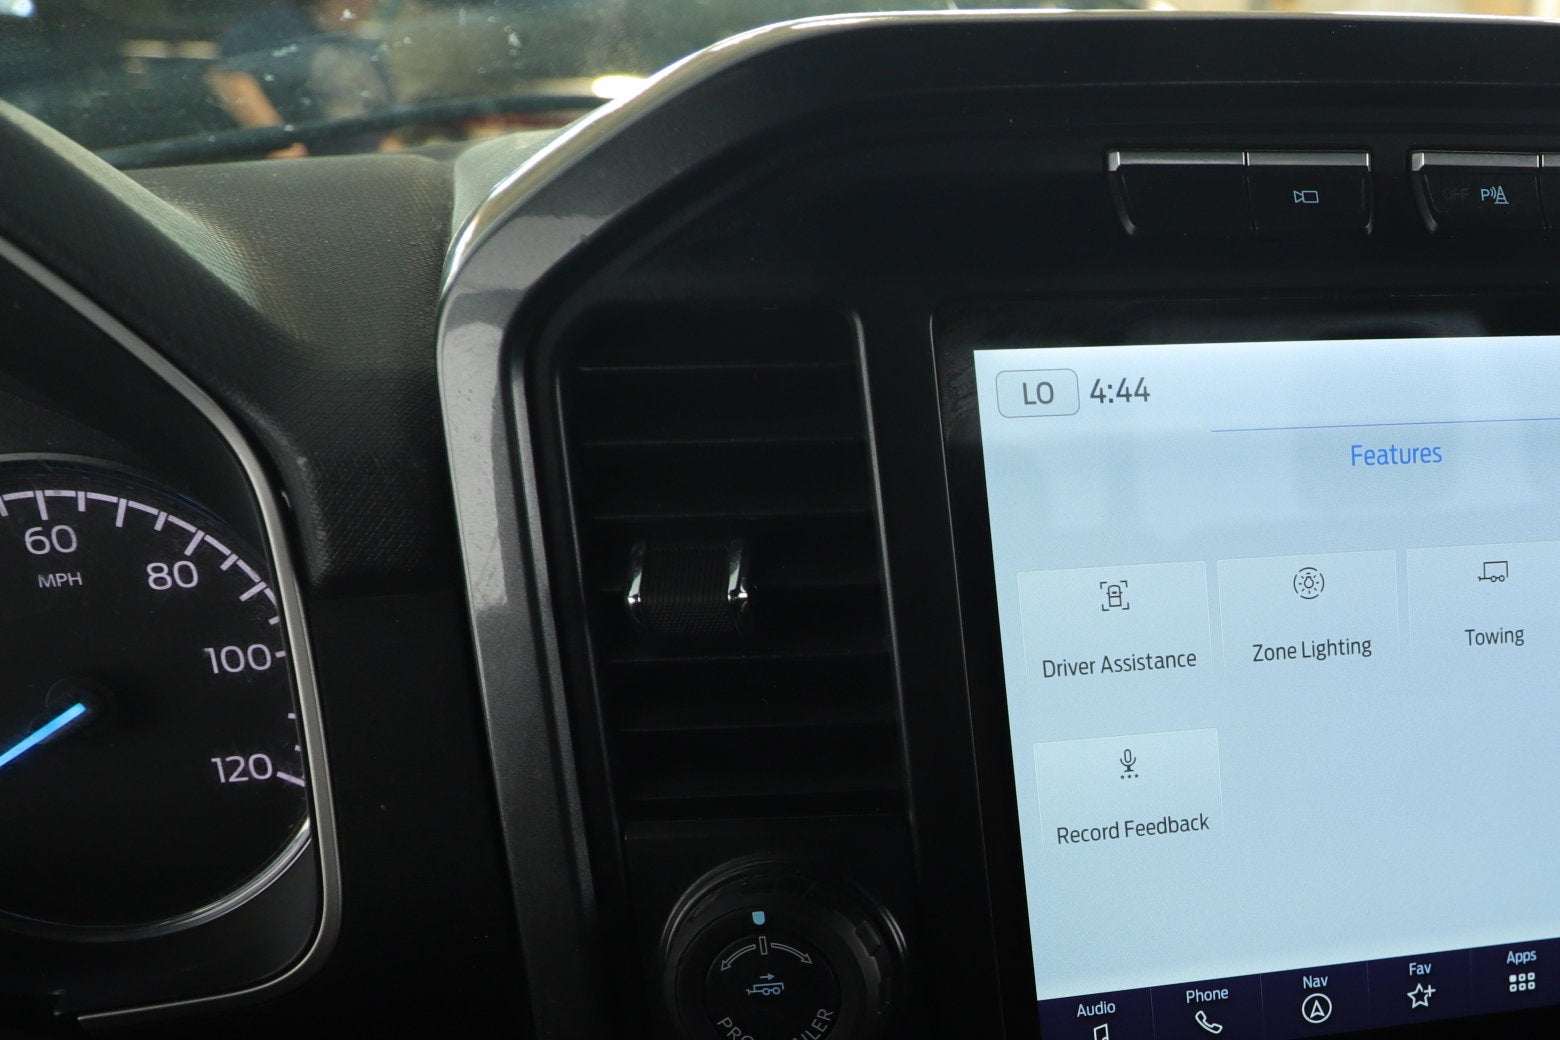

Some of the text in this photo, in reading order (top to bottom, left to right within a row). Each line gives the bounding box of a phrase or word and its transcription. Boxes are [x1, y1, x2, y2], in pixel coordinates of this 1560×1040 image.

[1022, 381, 1054, 405] LO
[1089, 377, 1151, 404] 4:44
[1350, 443, 1443, 467] Features
[24, 524, 78, 555] 60
[37, 571, 83, 588] MPH
[147, 560, 199, 591] 80
[1464, 625, 1525, 649] Towing
[204, 643, 272, 674] 100
[1252, 636, 1372, 663] Zone Lighting
[1042, 649, 1197, 679] Driver Assistance
[210, 752, 273, 783] 120
[1056, 813, 1211, 846] Record Feedback
[1408, 961, 1432, 976] Fav
[1506, 948, 1537, 966] Apps
[1302, 974, 1329, 989] Nav
[1185, 985, 1229, 1004] Phone
[1076, 1000, 1116, 1018] Audio
